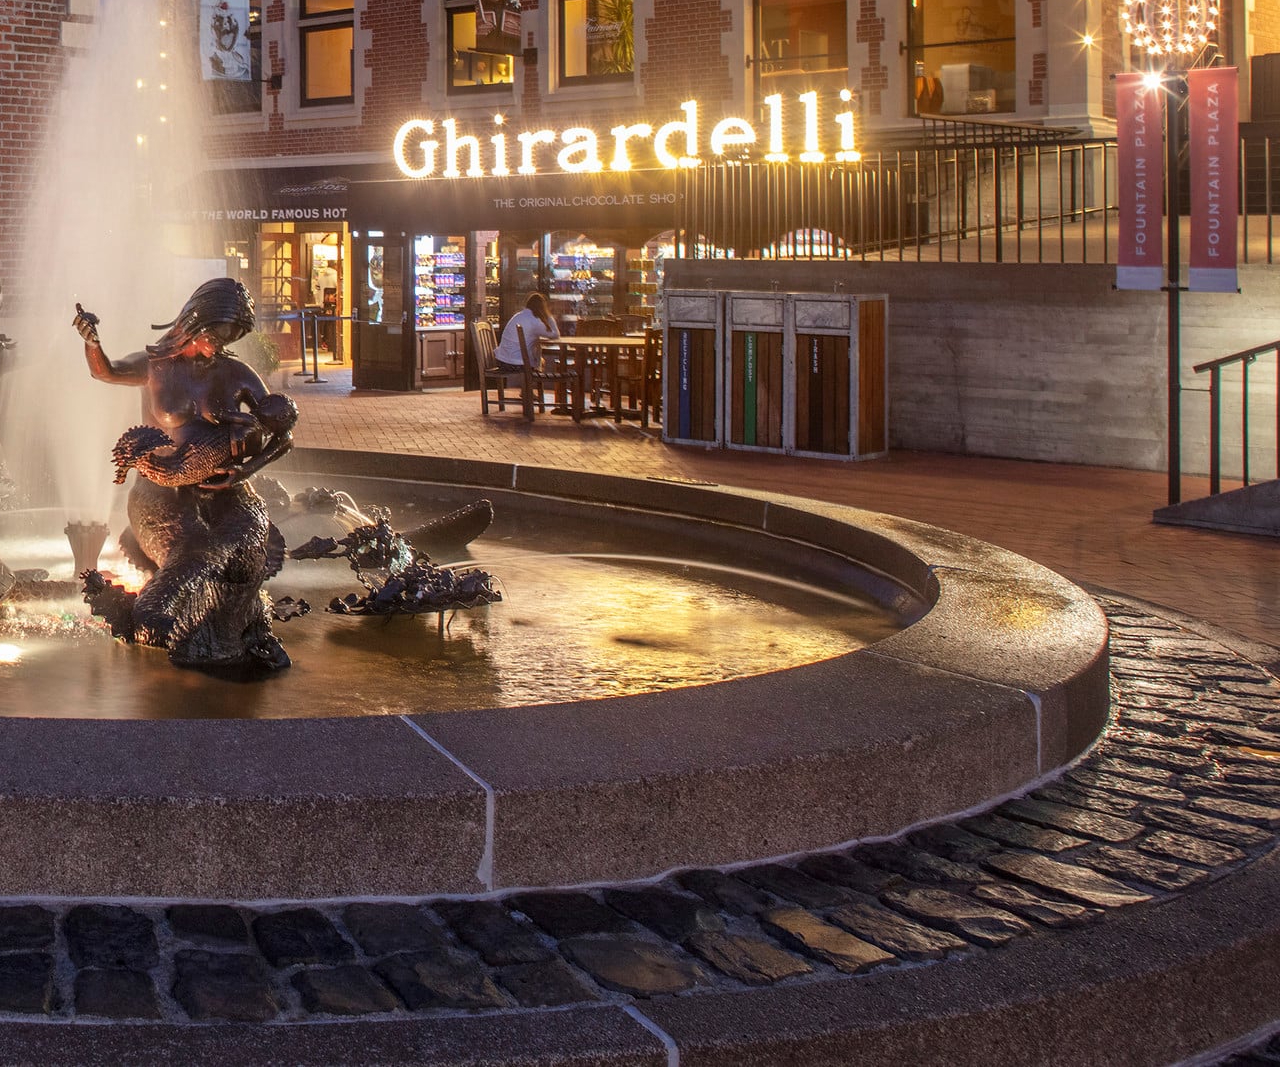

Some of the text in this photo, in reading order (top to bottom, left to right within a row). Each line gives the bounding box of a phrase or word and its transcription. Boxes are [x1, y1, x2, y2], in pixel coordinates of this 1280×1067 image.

[392, 88, 863, 180] Ghirardelli
[1134, 87, 1147, 257] FOUNTAIN PLAZA
[1207, 82, 1220, 258] FOUNTAIN PLAZA
[202, 210, 224, 221] THE
[226, 209, 269, 220] WORLD
[272, 208, 320, 220] FAMOUS
[323, 208, 348, 219] HOT
[493, 198, 515, 209] THE
[519, 196, 570, 208] ORIGINAL
[572, 194, 645, 207] CHOCOLATE
